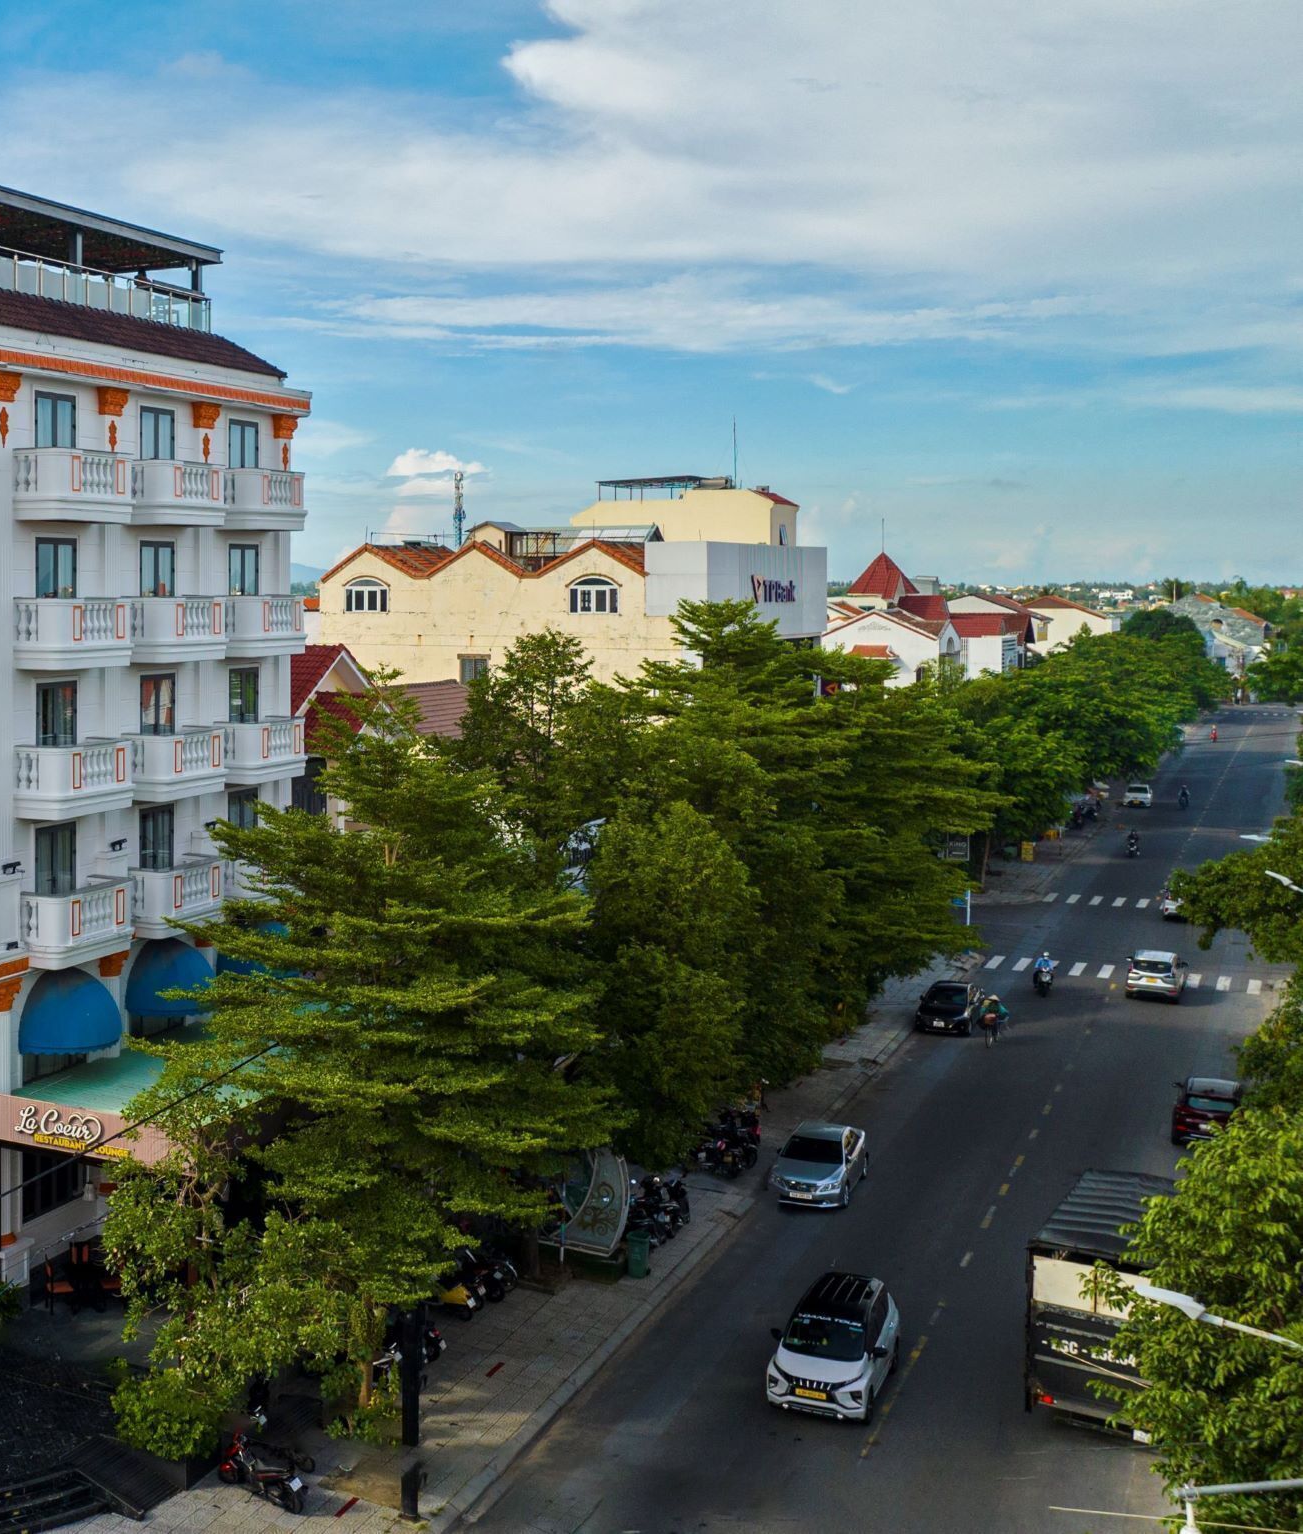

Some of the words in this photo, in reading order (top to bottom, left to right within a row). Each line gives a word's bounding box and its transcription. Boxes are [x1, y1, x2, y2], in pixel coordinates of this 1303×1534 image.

[14, 1104, 37, 1135] La
[40, 1109, 102, 1143] Coeur
[33, 1133, 86, 1151] RESTAURANT
[94, 1145, 130, 1159] LOUNGE
